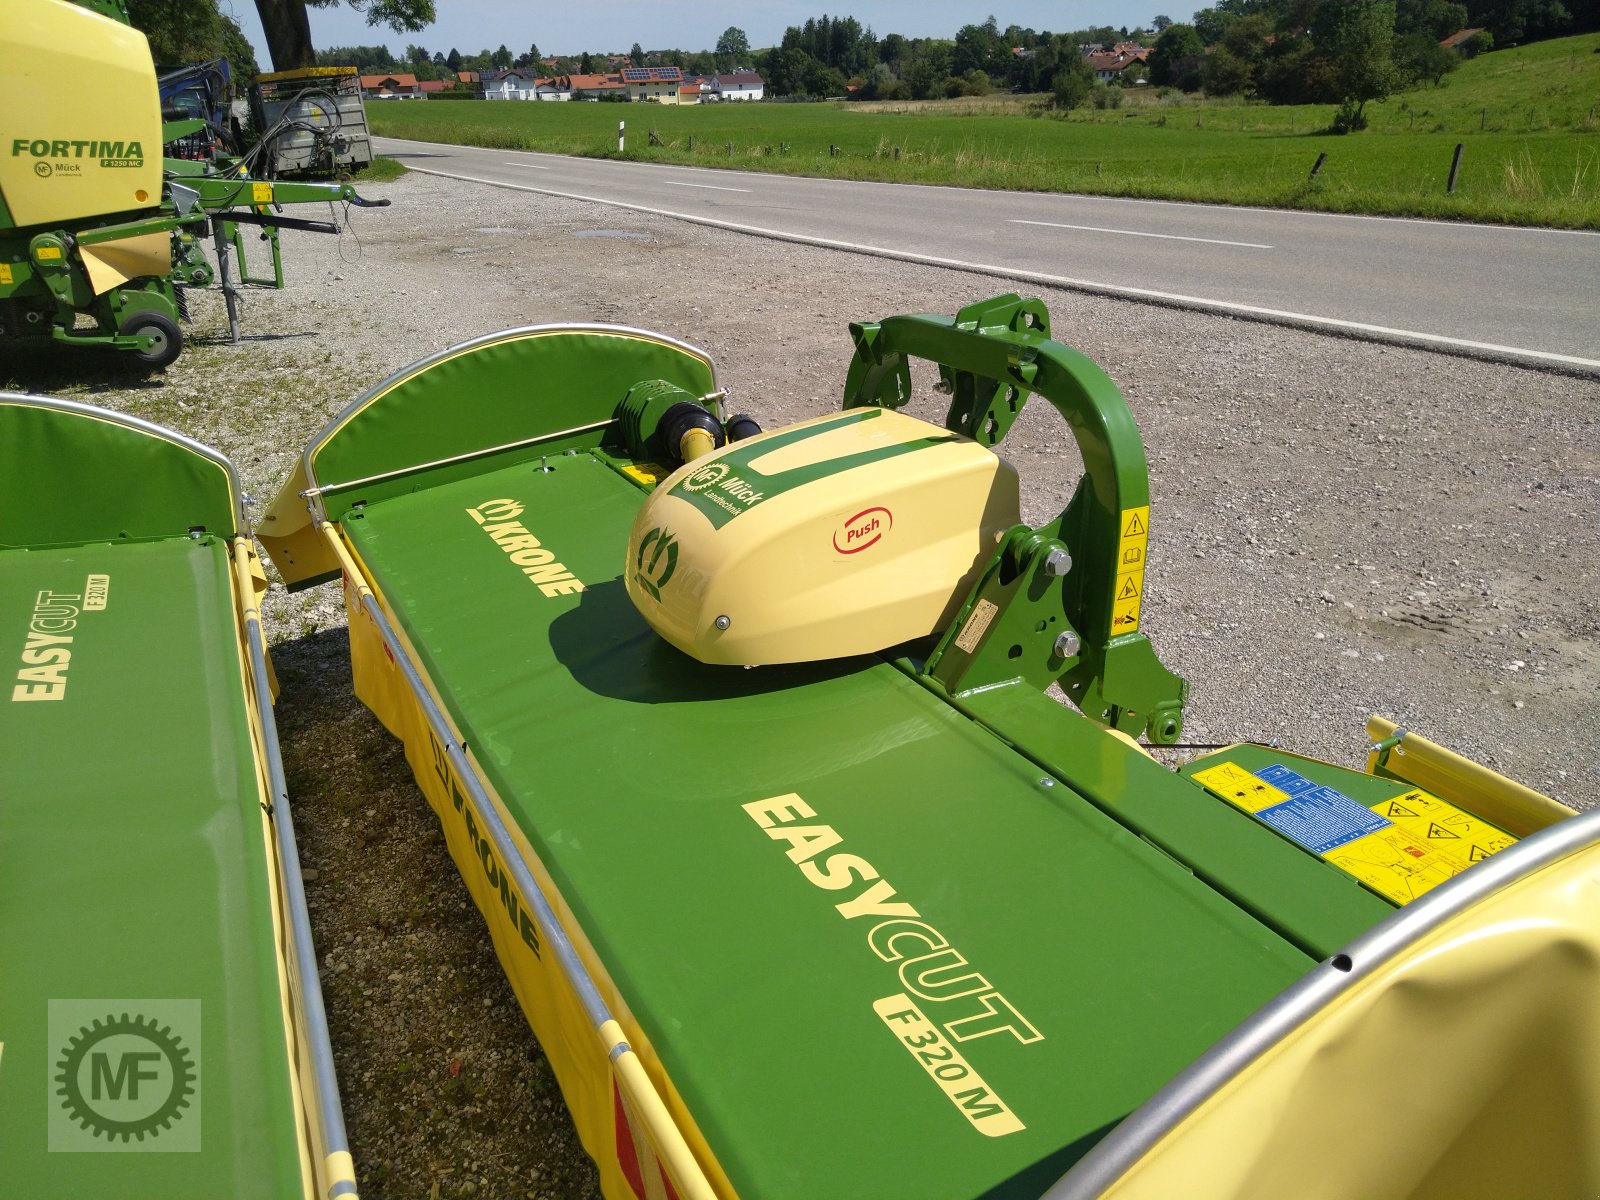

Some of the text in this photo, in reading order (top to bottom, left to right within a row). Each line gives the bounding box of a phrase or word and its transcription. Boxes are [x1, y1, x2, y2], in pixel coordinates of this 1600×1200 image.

[12, 139, 144, 158] FORTIMA
[55, 163, 81, 171] Mück
[703, 489, 743, 516] Landtechnik
[718, 476, 764, 506] Mück
[847, 518, 880, 543] Push
[482, 520, 589, 598] KRONE
[88, 587, 106, 600] 320
[12, 590, 81, 702] EASYCUT
[740, 792, 1046, 1045] EASYCUT
[885, 1008, 1005, 1120] F 320 M
